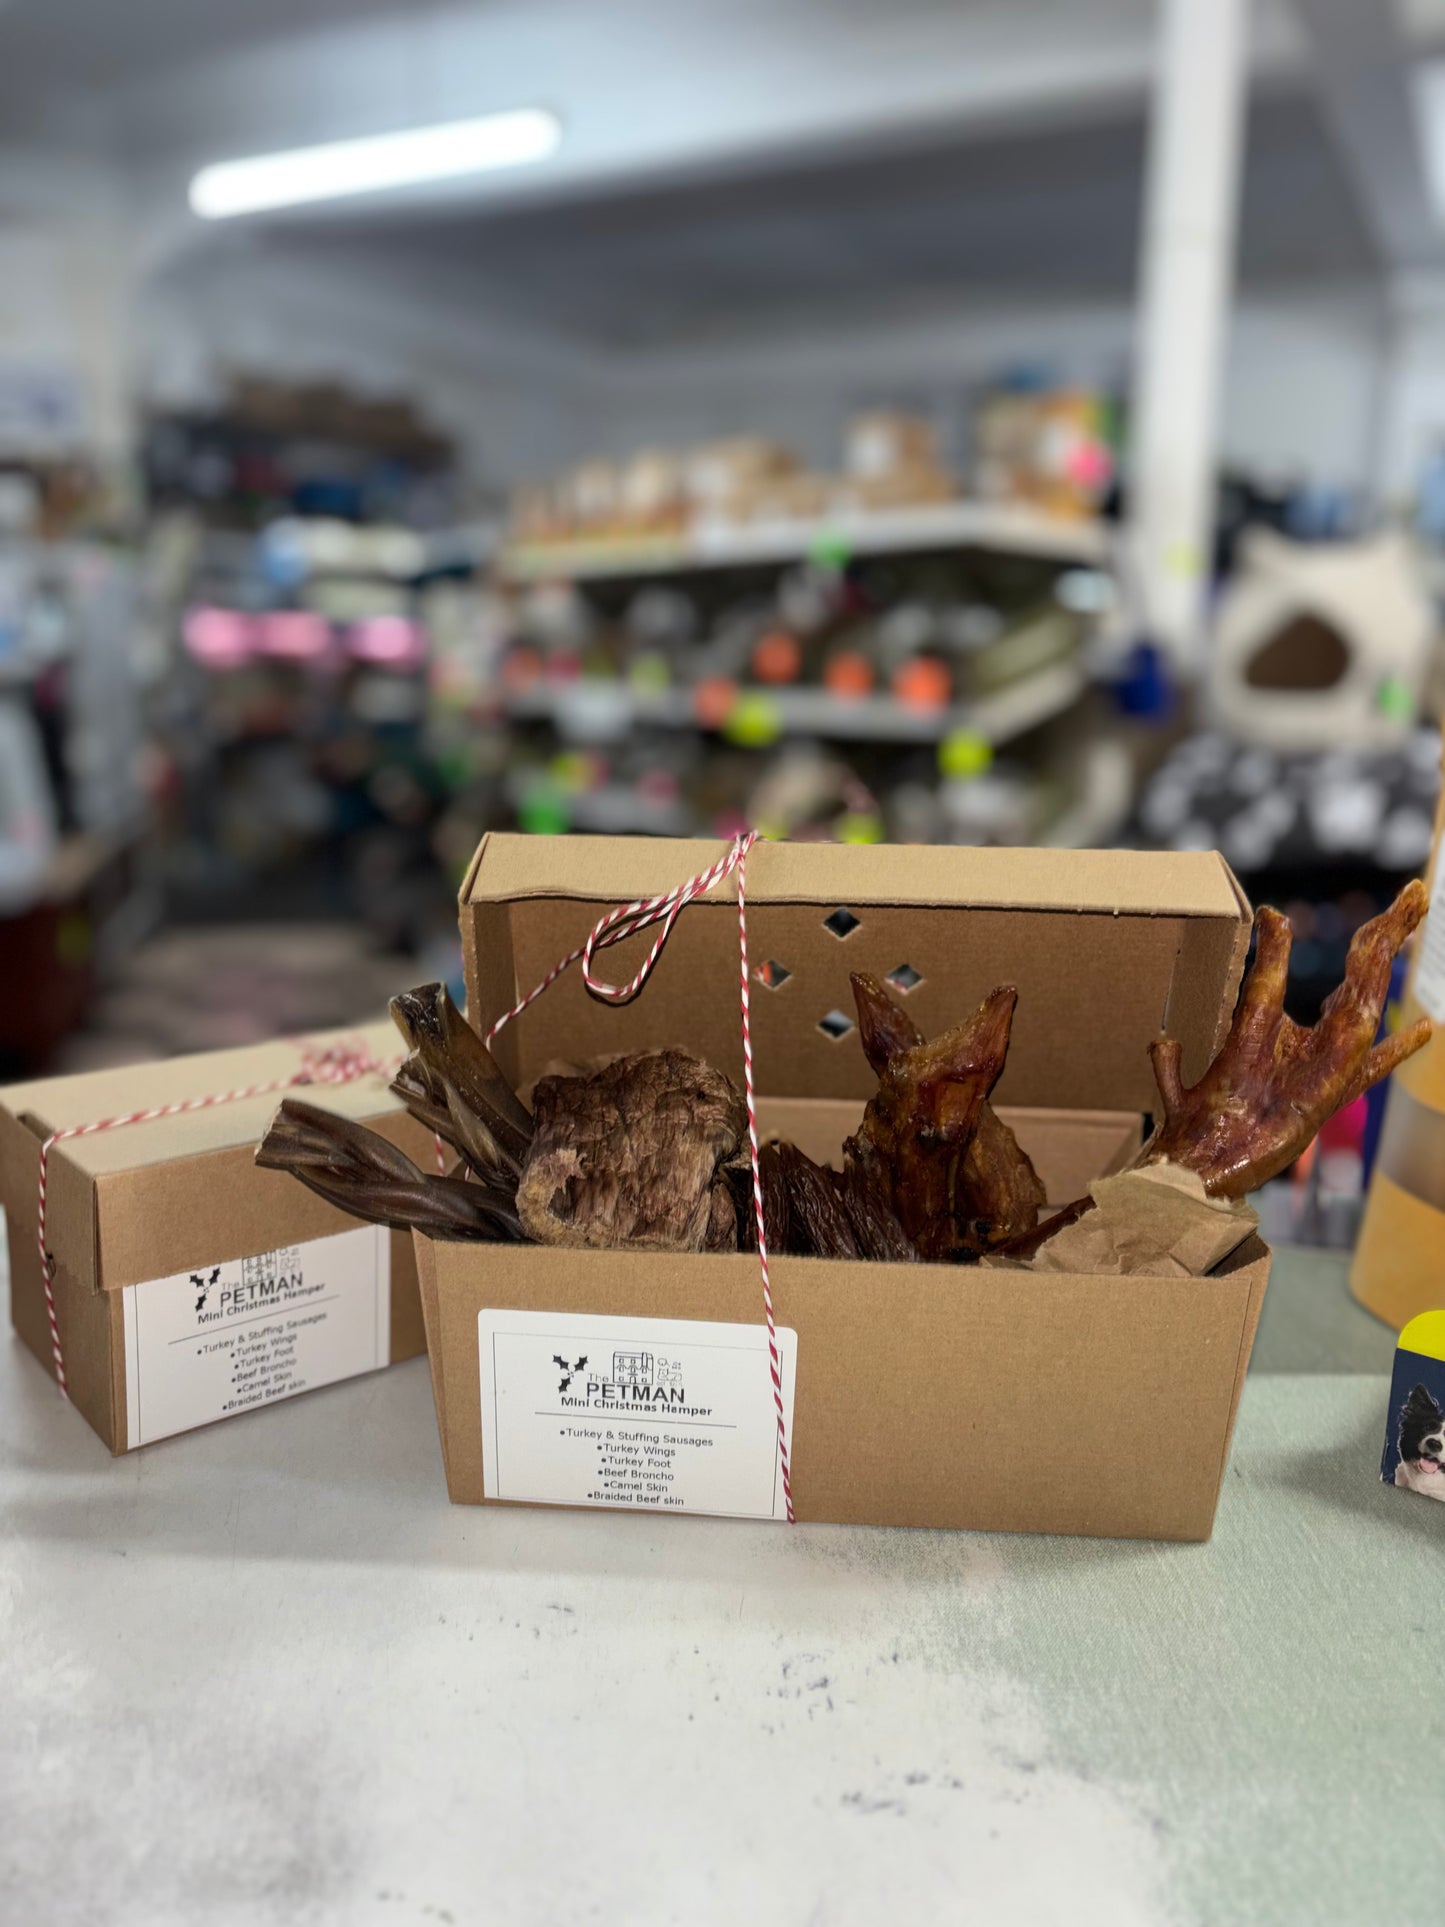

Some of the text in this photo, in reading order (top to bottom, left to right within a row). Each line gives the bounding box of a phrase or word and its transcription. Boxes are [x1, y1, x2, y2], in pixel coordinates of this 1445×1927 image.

[220, 1271, 303, 1307] PETMAN
[198, 1309, 223, 1324] Mini
[227, 1296, 281, 1316] Christmas
[203, 1312, 328, 1354] Turkey & Stuffing Sausages
[236, 1333, 298, 1357] Turkey Wings
[240, 1346, 295, 1368] Turkey Foot
[237, 1358, 298, 1382] Beef Broncho
[588, 1372, 609, 1383] The
[242, 1371, 292, 1392] Camel Skin
[228, 1379, 307, 1410] Braided Beef skin
[586, 1382, 685, 1403] PETMAN
[561, 1397, 713, 1417] Mini Christmas Hamper
[566, 1428, 714, 1447] Turkey & Stuffing Sausages
[603, 1443, 676, 1457] Turkey Wings
[608, 1456, 672, 1468] Turkey Foot
[604, 1468, 675, 1481] Beef Broncho
[610, 1480, 668, 1492] Camel Skin
[594, 1491, 684, 1506] Braided Beef skin
